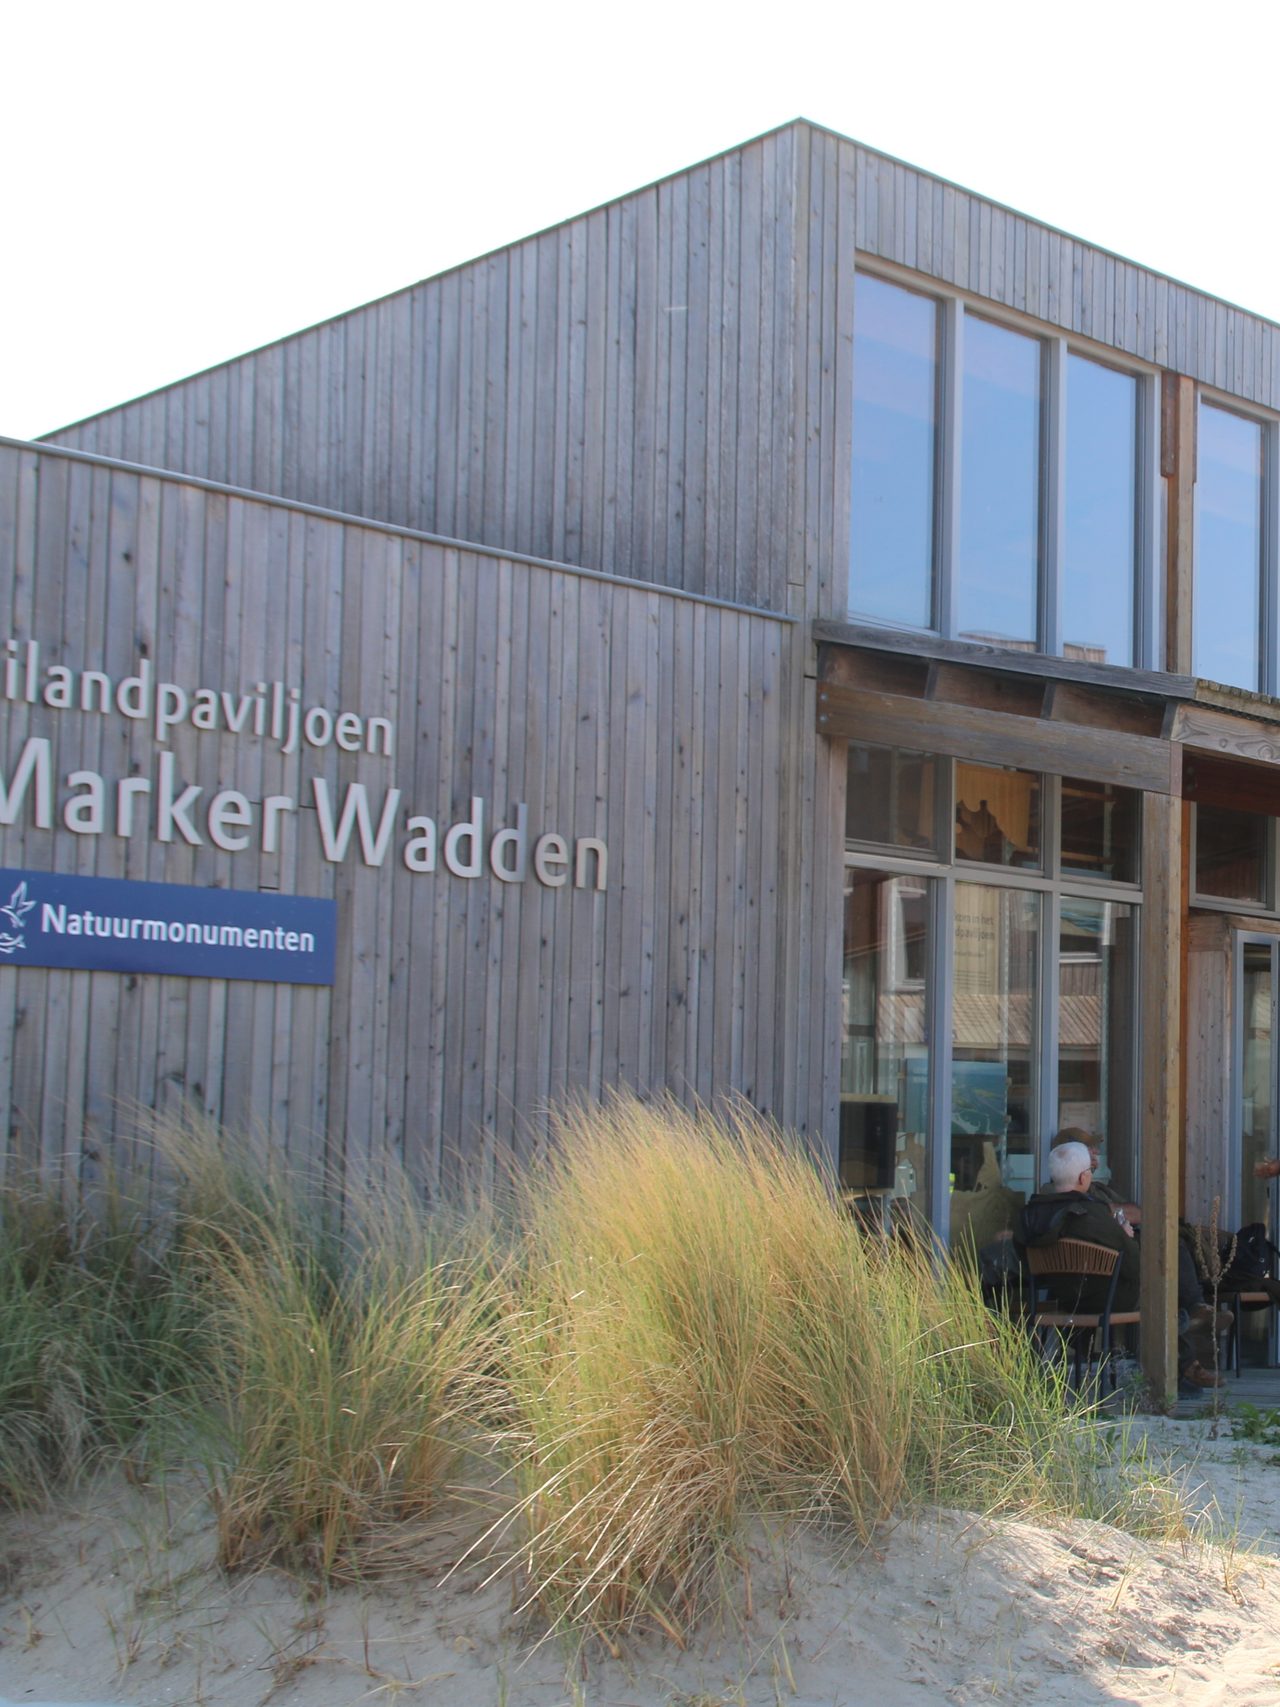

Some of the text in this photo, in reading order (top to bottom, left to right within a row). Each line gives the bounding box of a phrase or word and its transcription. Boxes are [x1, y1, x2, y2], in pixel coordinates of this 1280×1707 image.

[4, 639, 394, 756] ilandpaviljoen
[0, 736, 608, 892] Marker Wadden
[41, 902, 316, 953] Natuurmonumenten
